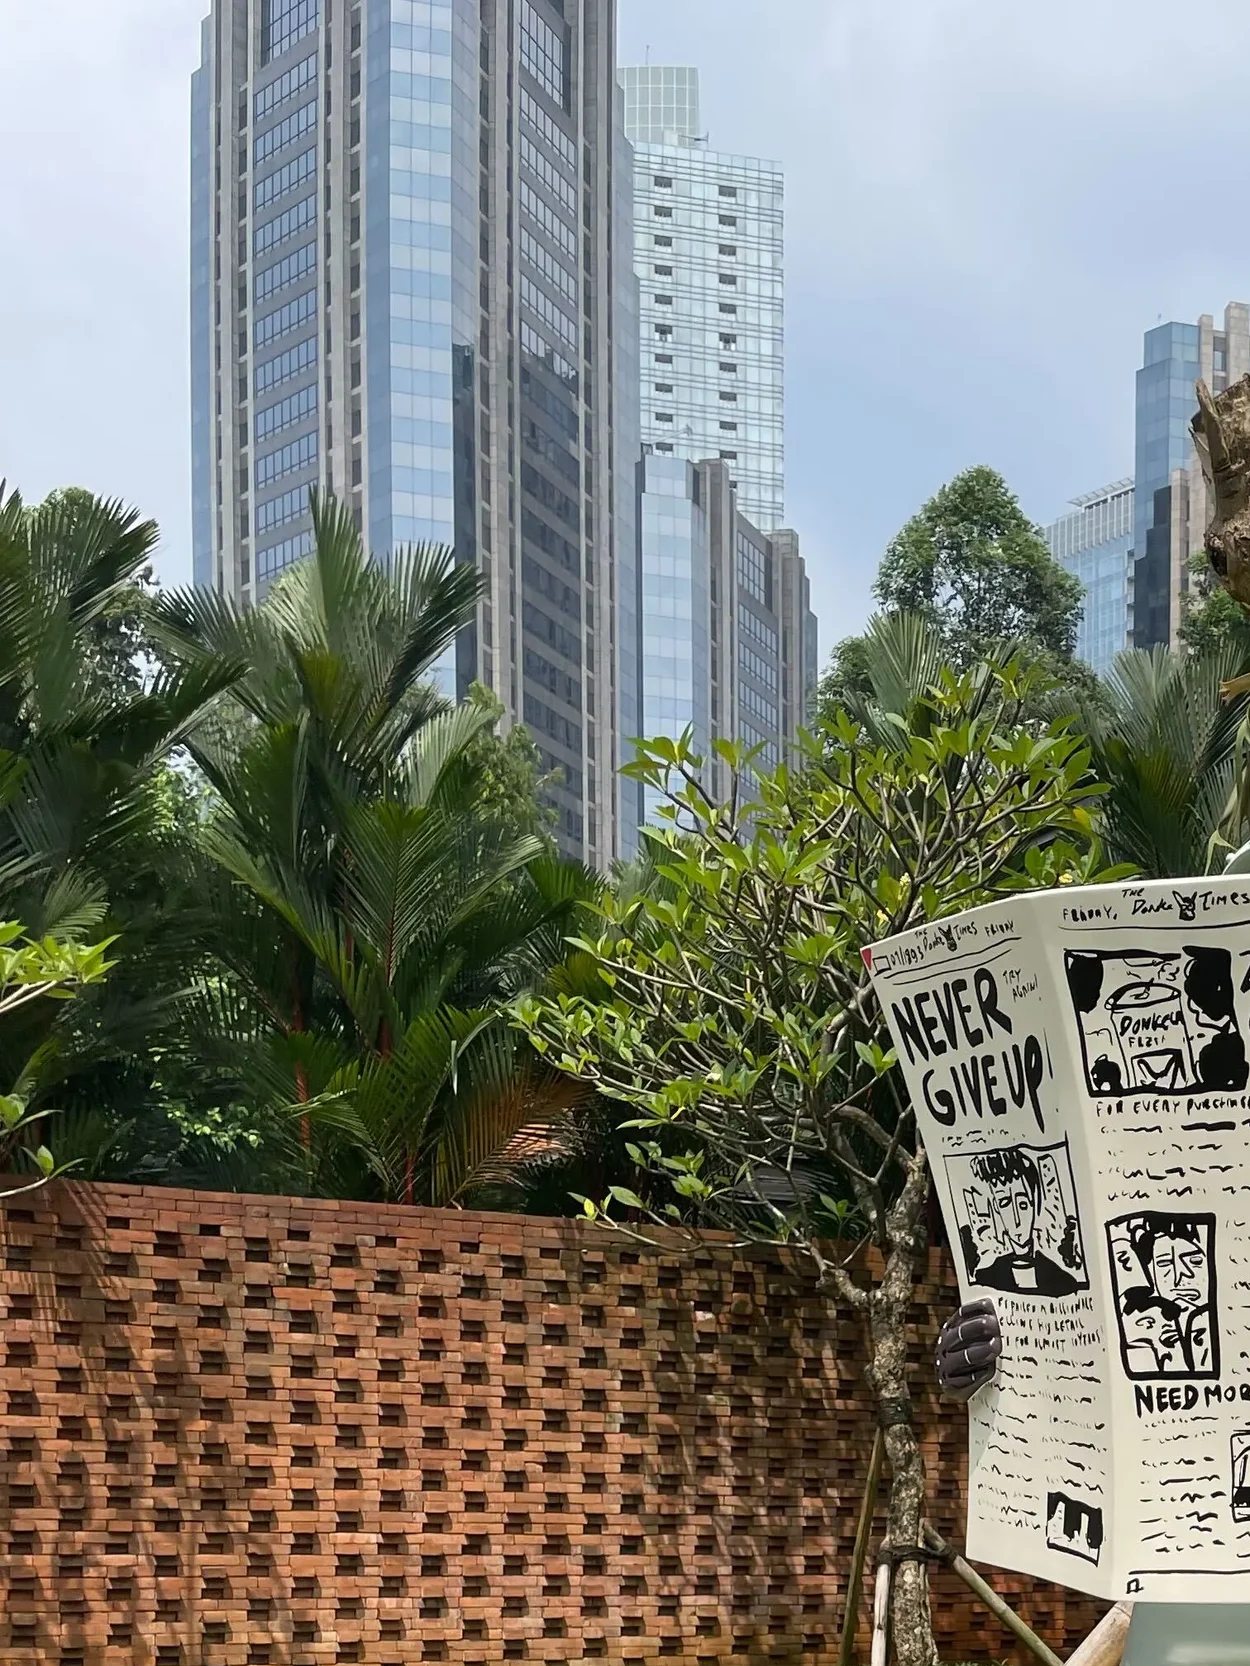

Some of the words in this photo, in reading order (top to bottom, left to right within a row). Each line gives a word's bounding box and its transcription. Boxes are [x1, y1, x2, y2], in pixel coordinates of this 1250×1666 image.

[1002, 968, 1021, 985] TRY
[891, 967, 1013, 1066] NEVER
[922, 1055, 1007, 1126] GIVE
[1096, 1100, 1123, 1117] FOR
[1133, 1098, 1180, 1115] EVERY
[1133, 1384, 1199, 1419] NEED
